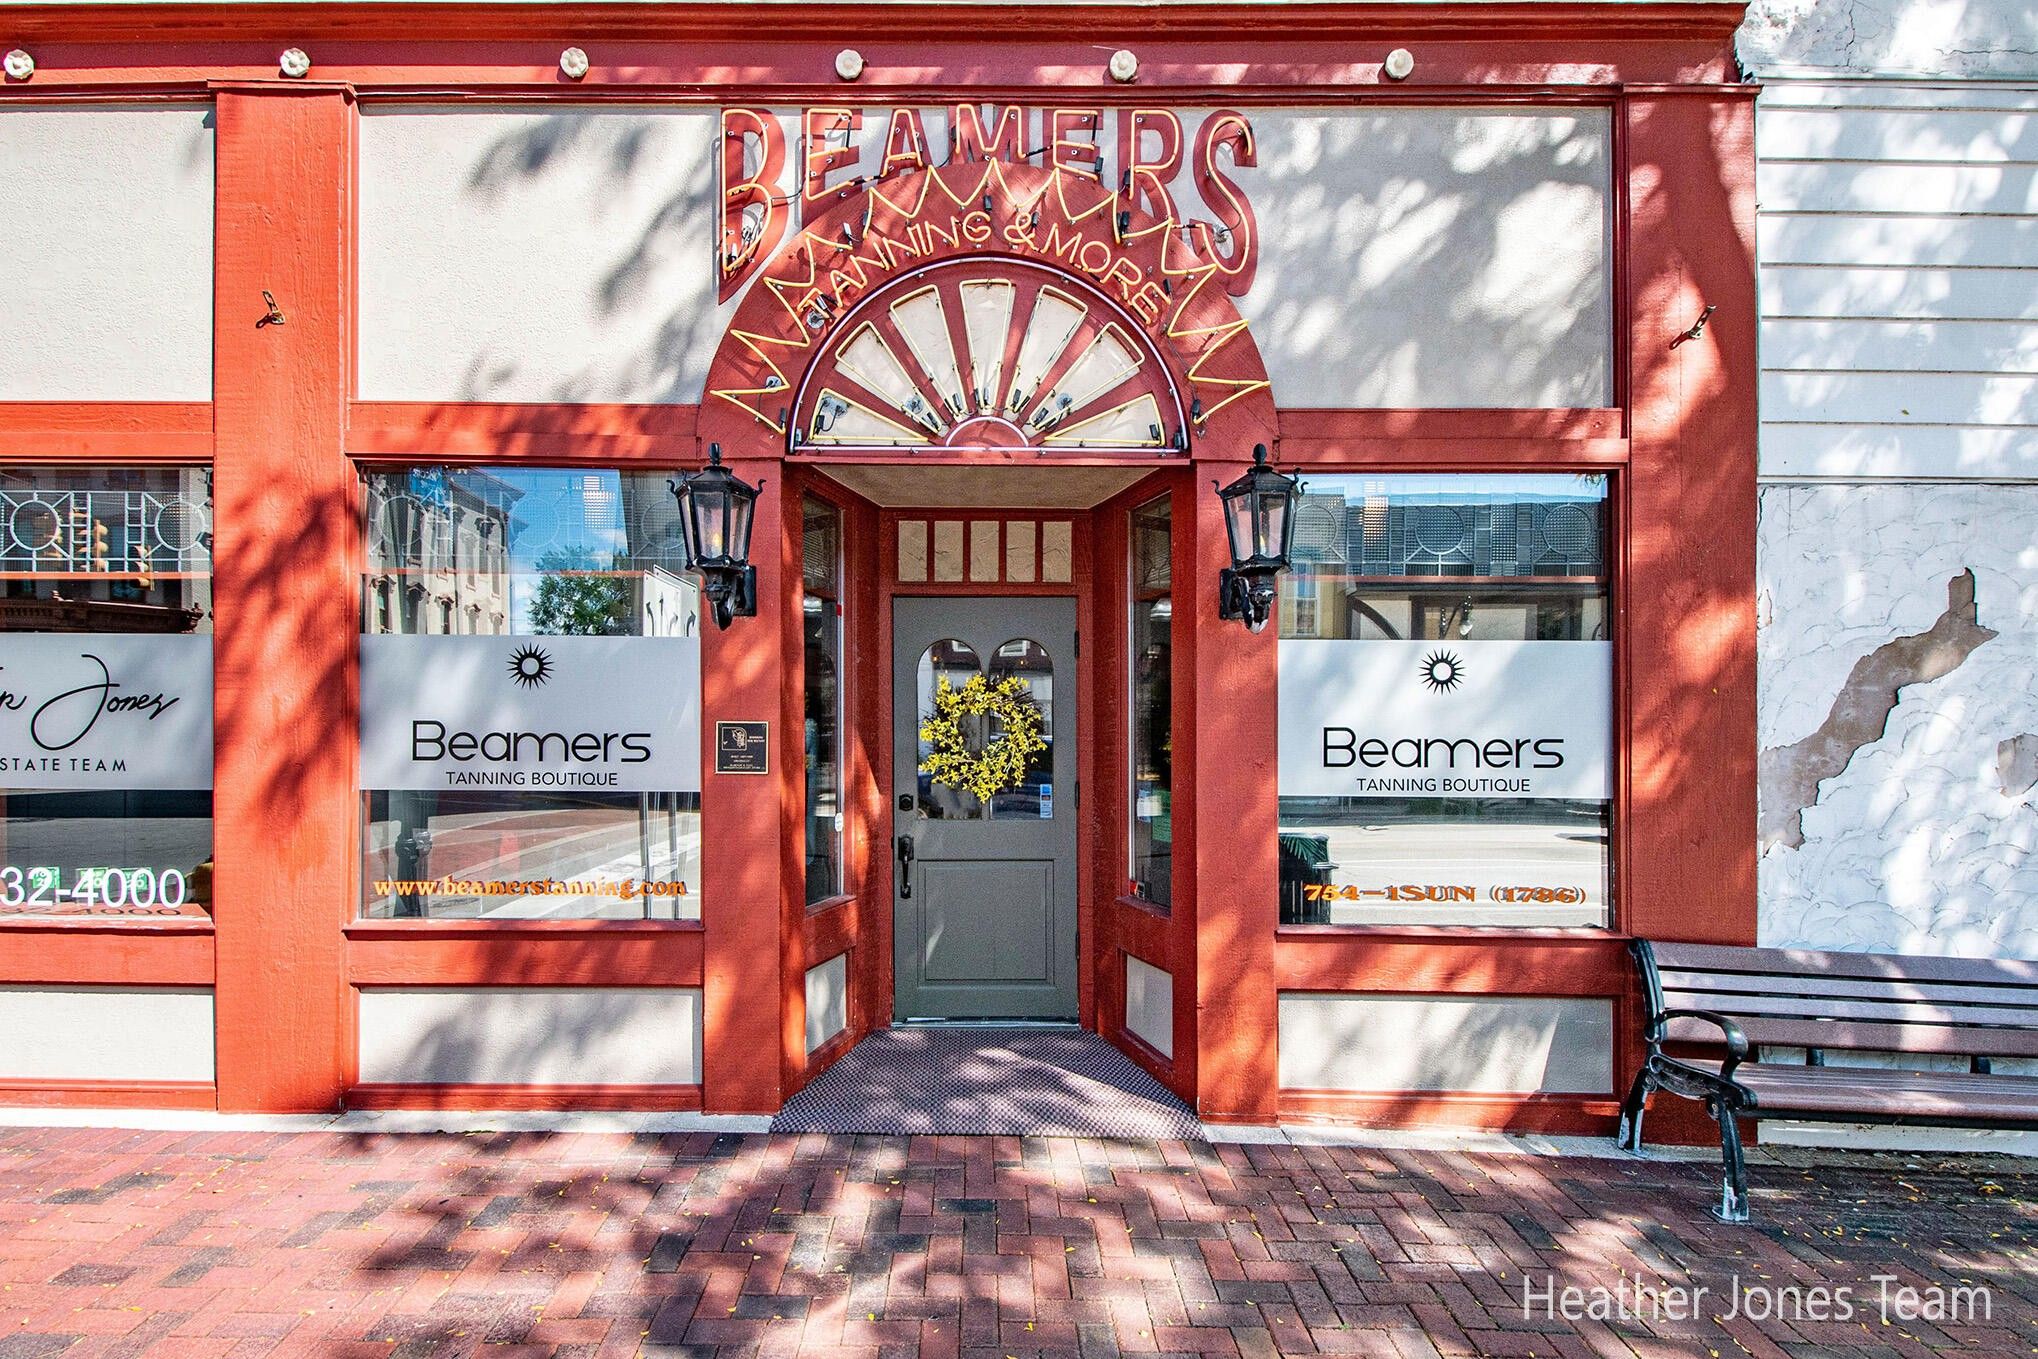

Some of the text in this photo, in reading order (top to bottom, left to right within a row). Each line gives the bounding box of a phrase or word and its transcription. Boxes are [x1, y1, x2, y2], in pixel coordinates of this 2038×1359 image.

[719, 104, 1258, 305] BEAMERS
[798, 211, 992, 320] TANNING
[30, 654, 180, 750] Jones
[412, 720, 651, 762] Beamers
[1323, 727, 1564, 768] Beamers
[70, 758, 127, 771] TEAM
[446, 772, 618, 786] TANNING BOUTIQUE
[1357, 778, 1531, 792] TANNING BOUTIQUE
[373, 875, 688, 900] www.beamerstanning.com
[1303, 884, 1587, 904] 754-1SUN (1786)
